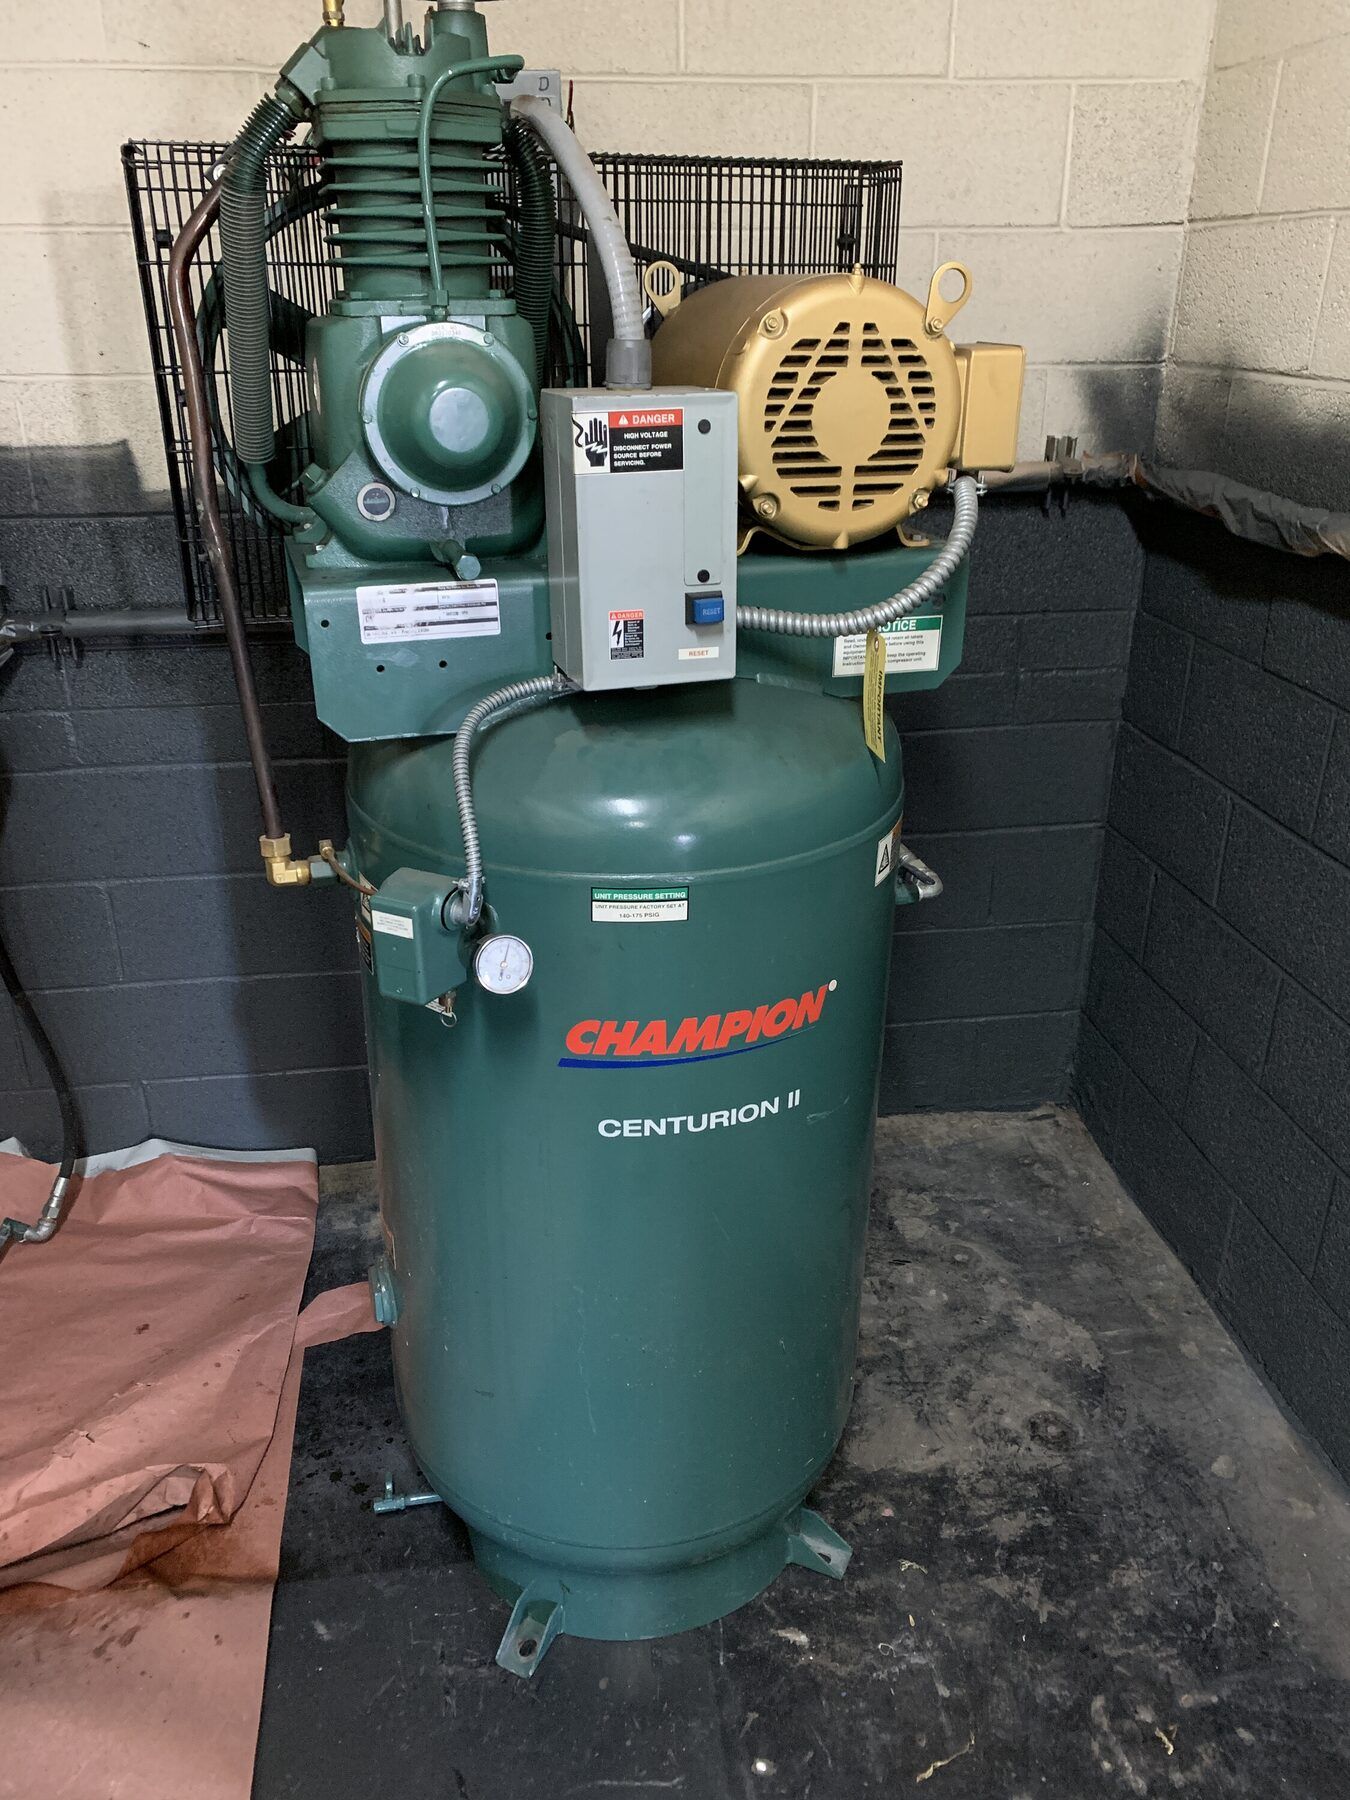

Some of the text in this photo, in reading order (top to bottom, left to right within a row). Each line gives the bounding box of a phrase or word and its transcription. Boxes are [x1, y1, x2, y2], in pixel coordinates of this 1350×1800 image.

[632, 413, 675, 425] DANGER
[640, 431, 668, 439] VOLTAGE
[617, 611, 643, 619] DANGER
[702, 607, 721, 616] RESET
[688, 649, 709, 657] RESET
[565, 984, 828, 1056] CHAMPION
[597, 1088, 801, 1138] CENTURION II
